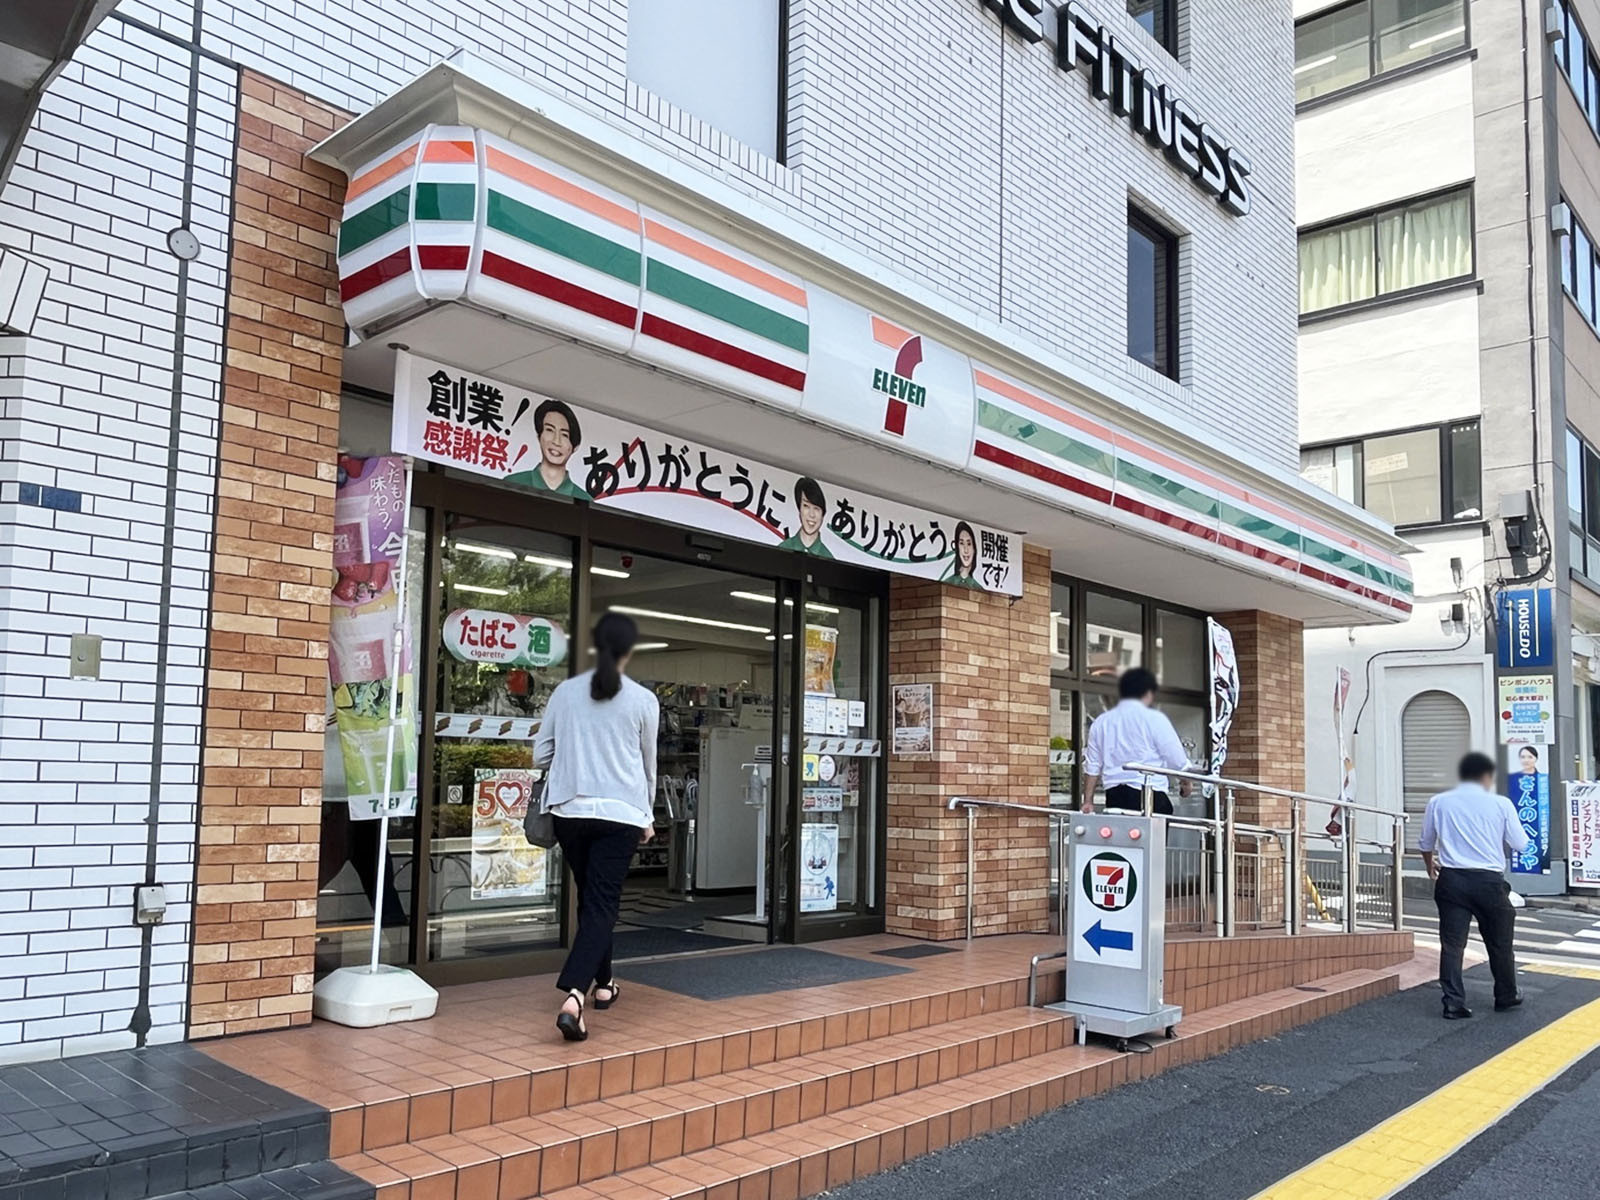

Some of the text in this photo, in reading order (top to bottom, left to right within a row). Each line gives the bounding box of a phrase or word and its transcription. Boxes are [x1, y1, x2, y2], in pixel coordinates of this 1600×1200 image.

[871, 315, 923, 437] 7
[426, 370, 530, 435] 創業!
[423, 420, 528, 473] 感謝祭!
[981, 529, 1009, 563] 開催
[459, 615, 552, 655] たばこ 酒
[1517, 598, 1532, 659] HOUSEDO
[470, 649, 506, 660] cigarette
[1096, 865, 1124, 907] 7
